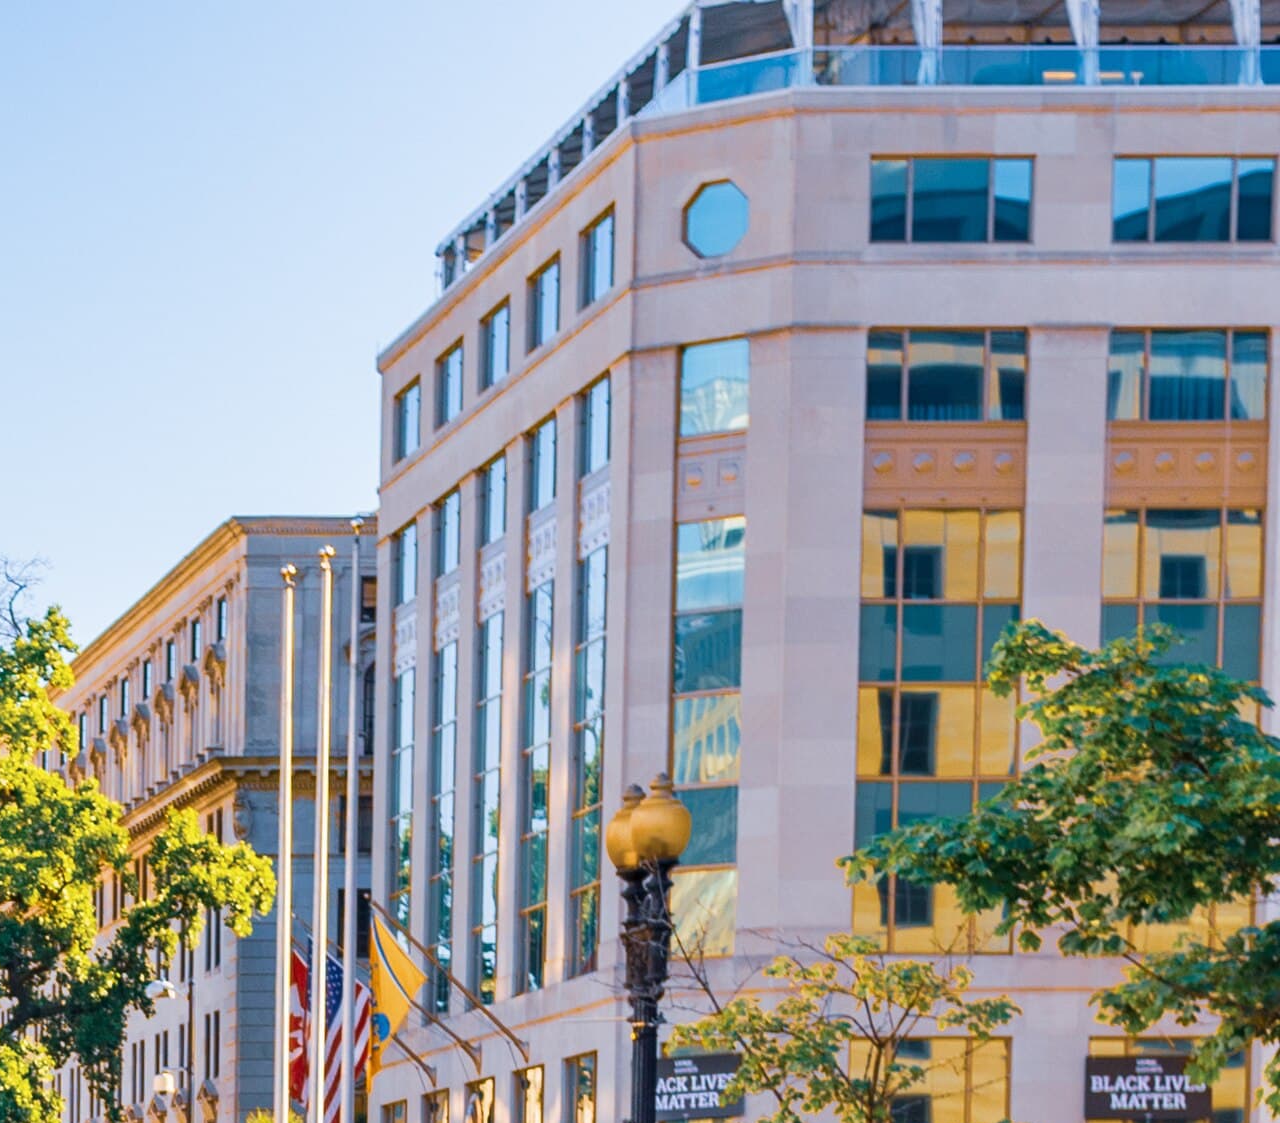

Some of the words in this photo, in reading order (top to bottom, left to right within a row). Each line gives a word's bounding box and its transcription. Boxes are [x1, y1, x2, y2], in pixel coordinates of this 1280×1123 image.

[656, 1076, 688, 1093] ACK
[1090, 1075, 1150, 1092] BLACK
[655, 1092, 720, 1110] MATTER
[1110, 1093, 1187, 1110] MATTER
